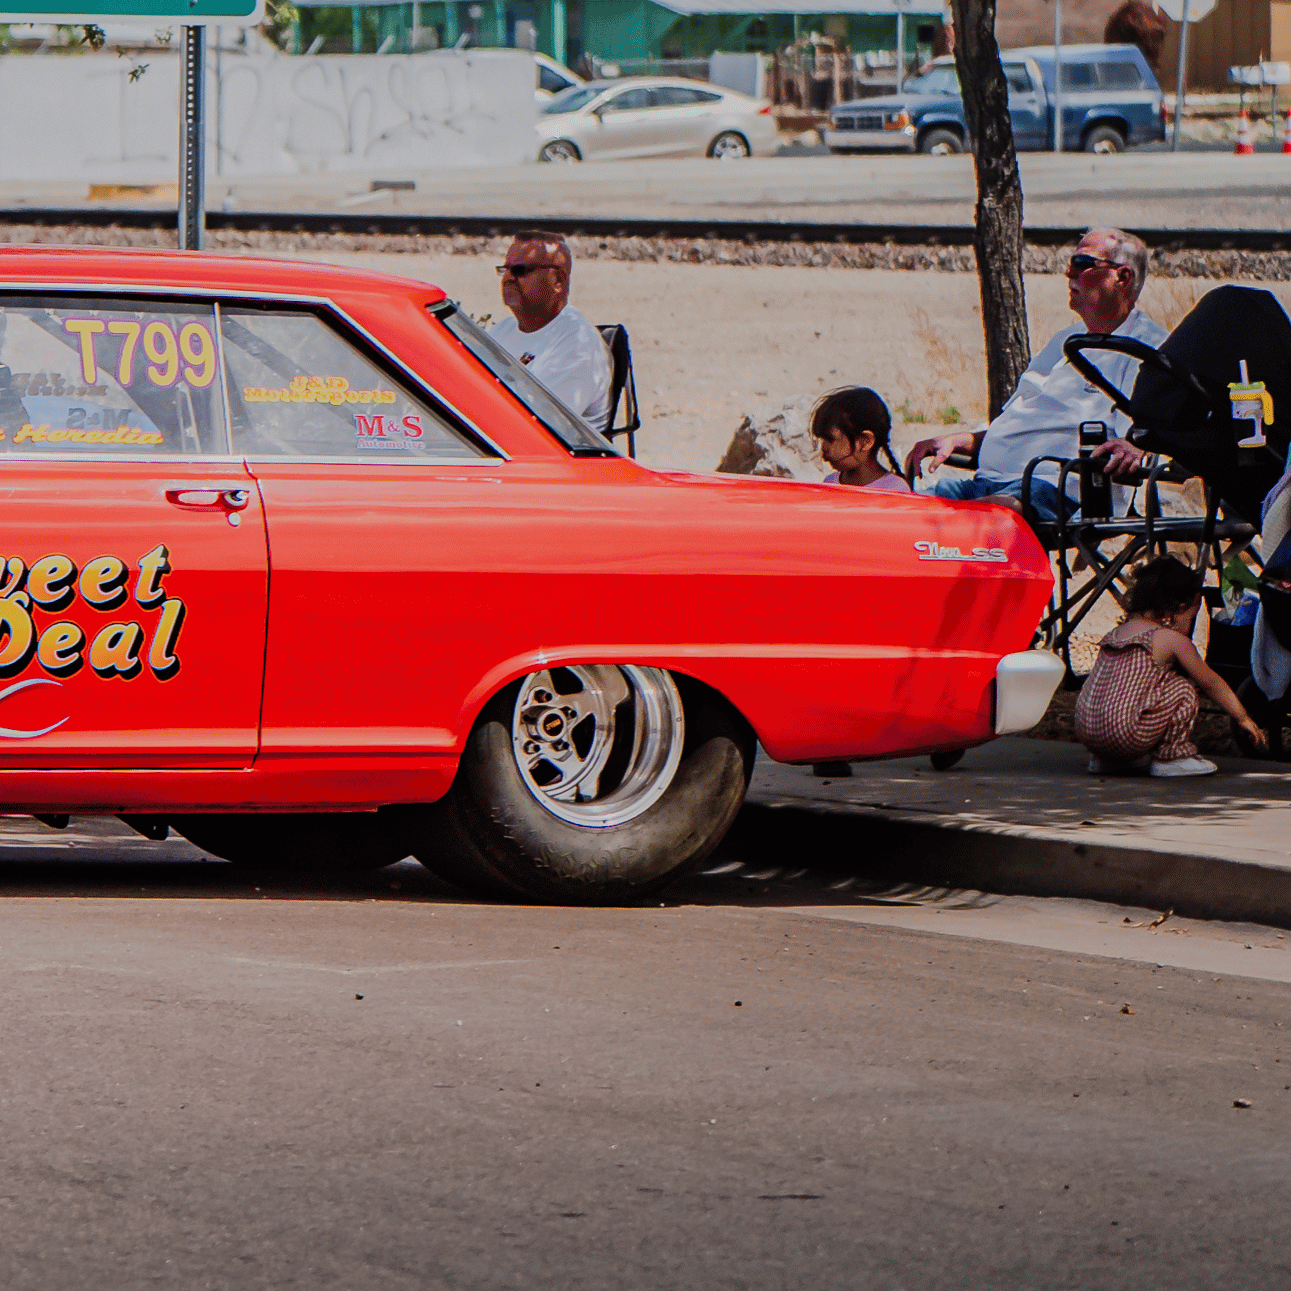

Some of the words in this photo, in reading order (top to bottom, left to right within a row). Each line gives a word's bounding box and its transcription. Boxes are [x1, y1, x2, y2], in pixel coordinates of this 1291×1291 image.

[64, 317, 218, 389] T799
[356, 438, 426, 450] Automotive
[972, 547, 1007, 561] SS
